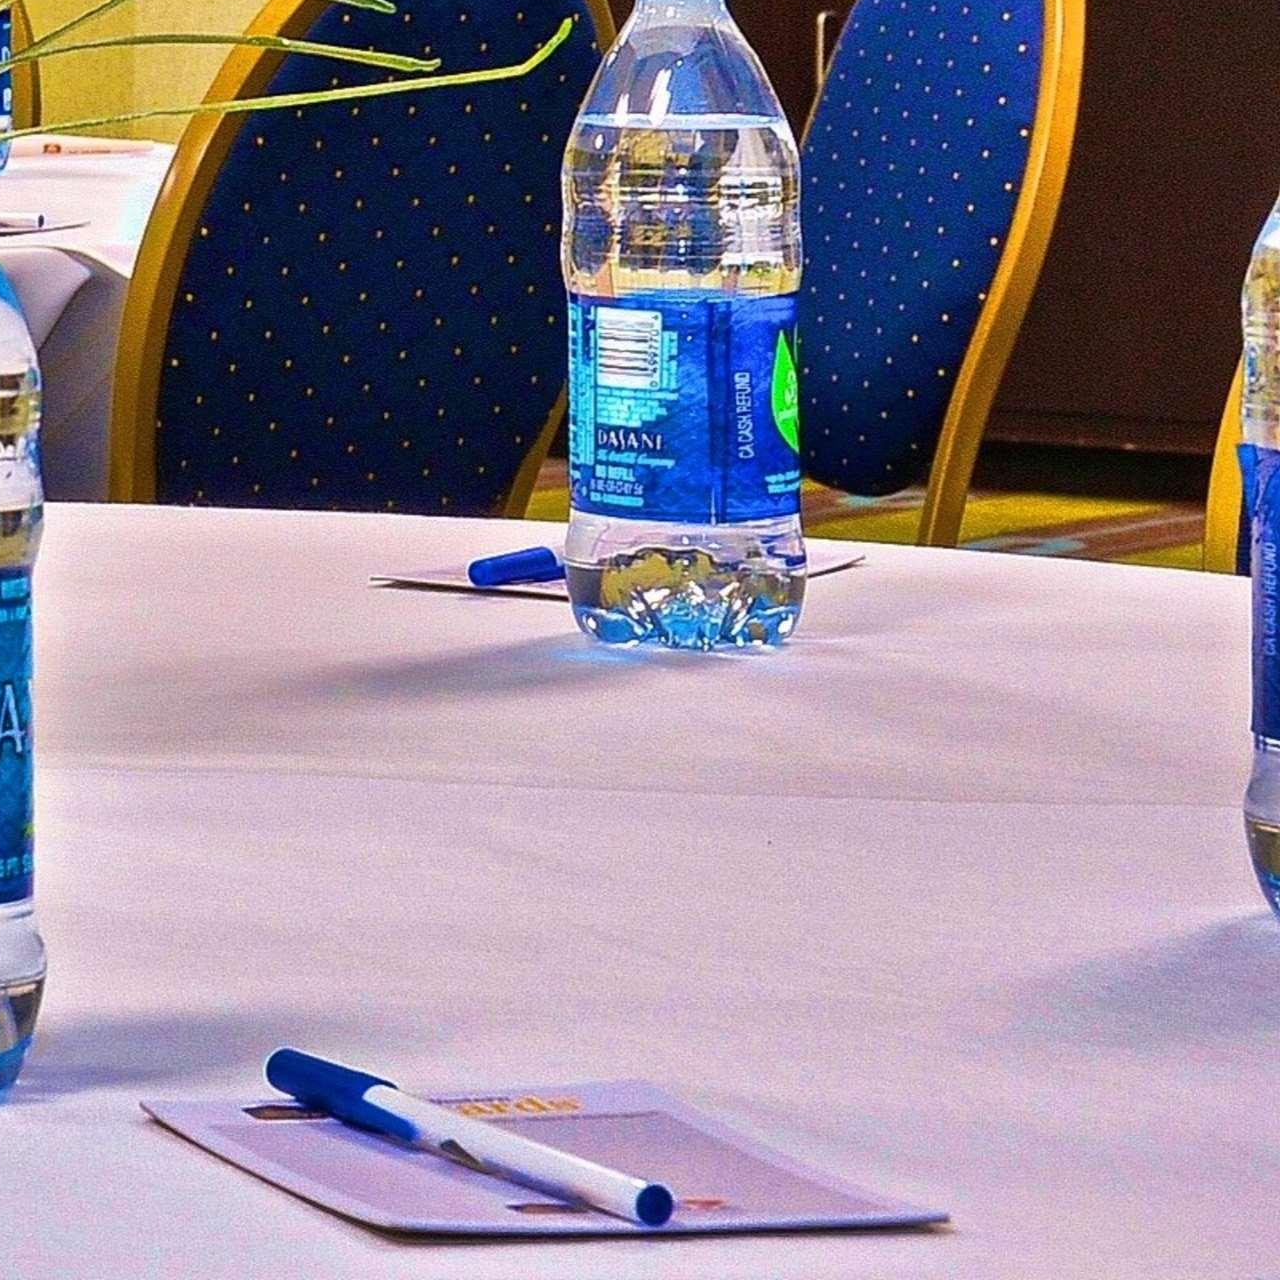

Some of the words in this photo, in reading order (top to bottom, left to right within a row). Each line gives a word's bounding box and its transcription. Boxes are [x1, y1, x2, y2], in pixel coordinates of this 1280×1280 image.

[734, 372, 752, 413] REFUND
[597, 428, 662, 451] DASANI
[737, 414, 753, 442] CASH
[738, 442, 754, 459] CA
